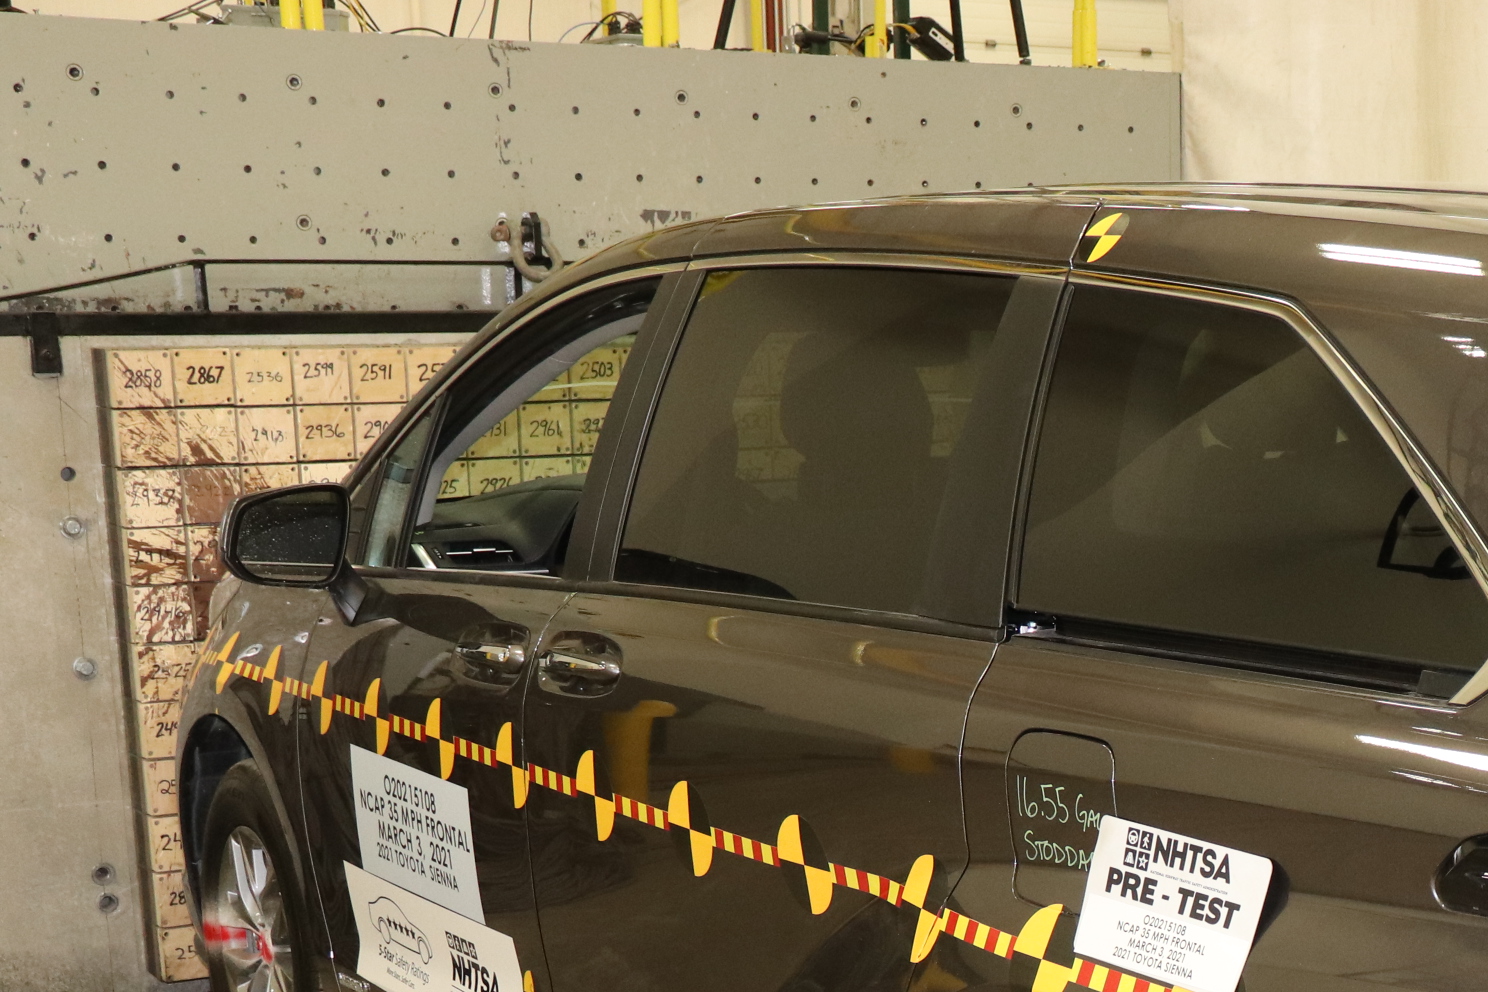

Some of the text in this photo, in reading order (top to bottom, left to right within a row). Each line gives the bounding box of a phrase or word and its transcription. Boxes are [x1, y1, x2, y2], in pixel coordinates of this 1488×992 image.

[123, 368, 162, 389] 2858
[186, 366, 225, 385] 2867
[245, 371, 283, 383] 2536
[302, 363, 334, 379] 2599
[359, 363, 392, 382] 2591
[417, 363, 446, 382] 25
[580, 361, 614, 380] 2503
[305, 424, 345, 440] 2936
[583, 417, 606, 434] 29
[140, 602, 185, 621] 2946
[1016, 774, 1069, 824] 16.55
[360, 787, 471, 854] NCAP 35 MPH FRONTAL
[378, 819, 453, 870] MARCH 3, 2021
[376, 841, 460, 893] 2021 TOYOTA SIENNA
[1152, 834, 1231, 885] NHTSA
[1105, 866, 1159, 906] PRE
[1178, 886, 1242, 930] TEST
[1117, 920, 1206, 956] NCAP 35 MPH FRONTAL
[1127, 937, 1187, 964] MARCH 3, 2021
[1112, 946, 1194, 980] 2021 TOYOTA SIENNA
